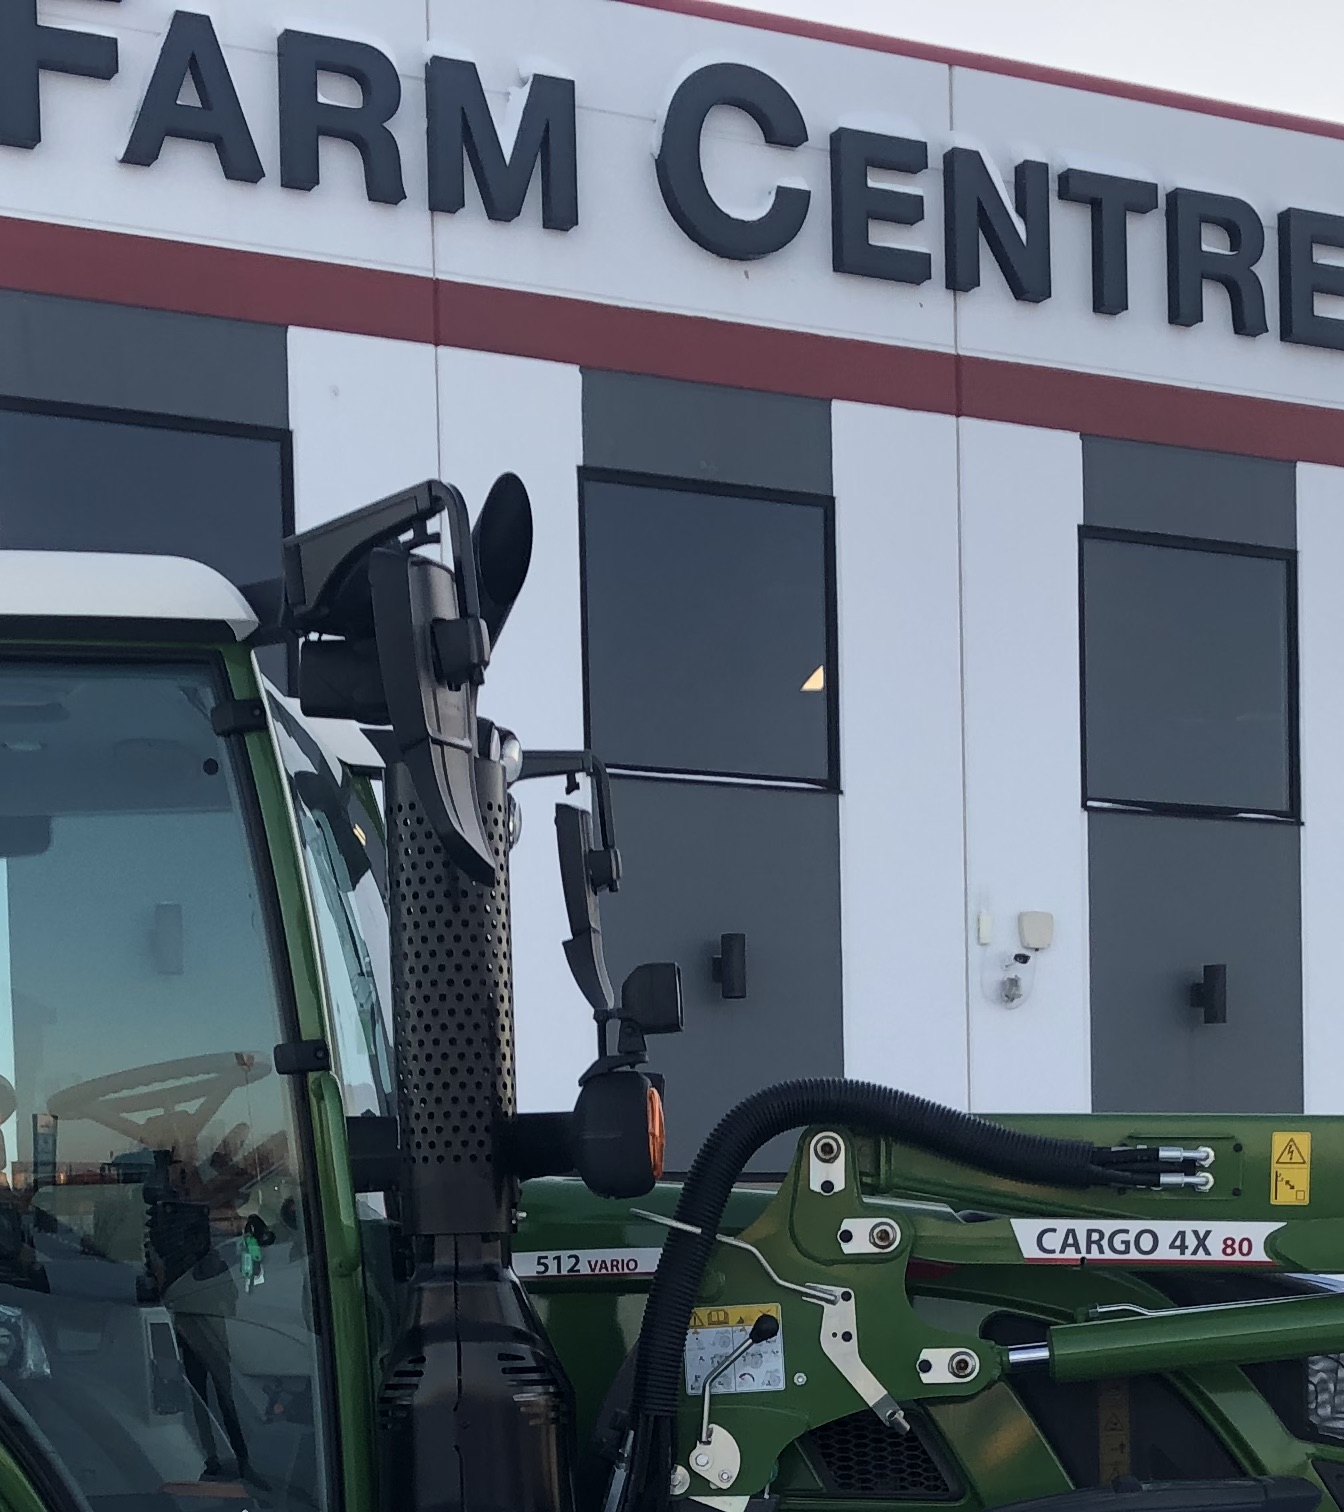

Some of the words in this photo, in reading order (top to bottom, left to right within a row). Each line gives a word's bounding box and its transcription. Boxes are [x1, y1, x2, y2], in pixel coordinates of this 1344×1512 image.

[1036, 1227, 1159, 1255] CARGO
[1168, 1229, 1212, 1256] 4X
[1221, 1236, 1254, 1257] 80
[535, 1254, 581, 1275] 512
[587, 1258, 638, 1273] VARIO
